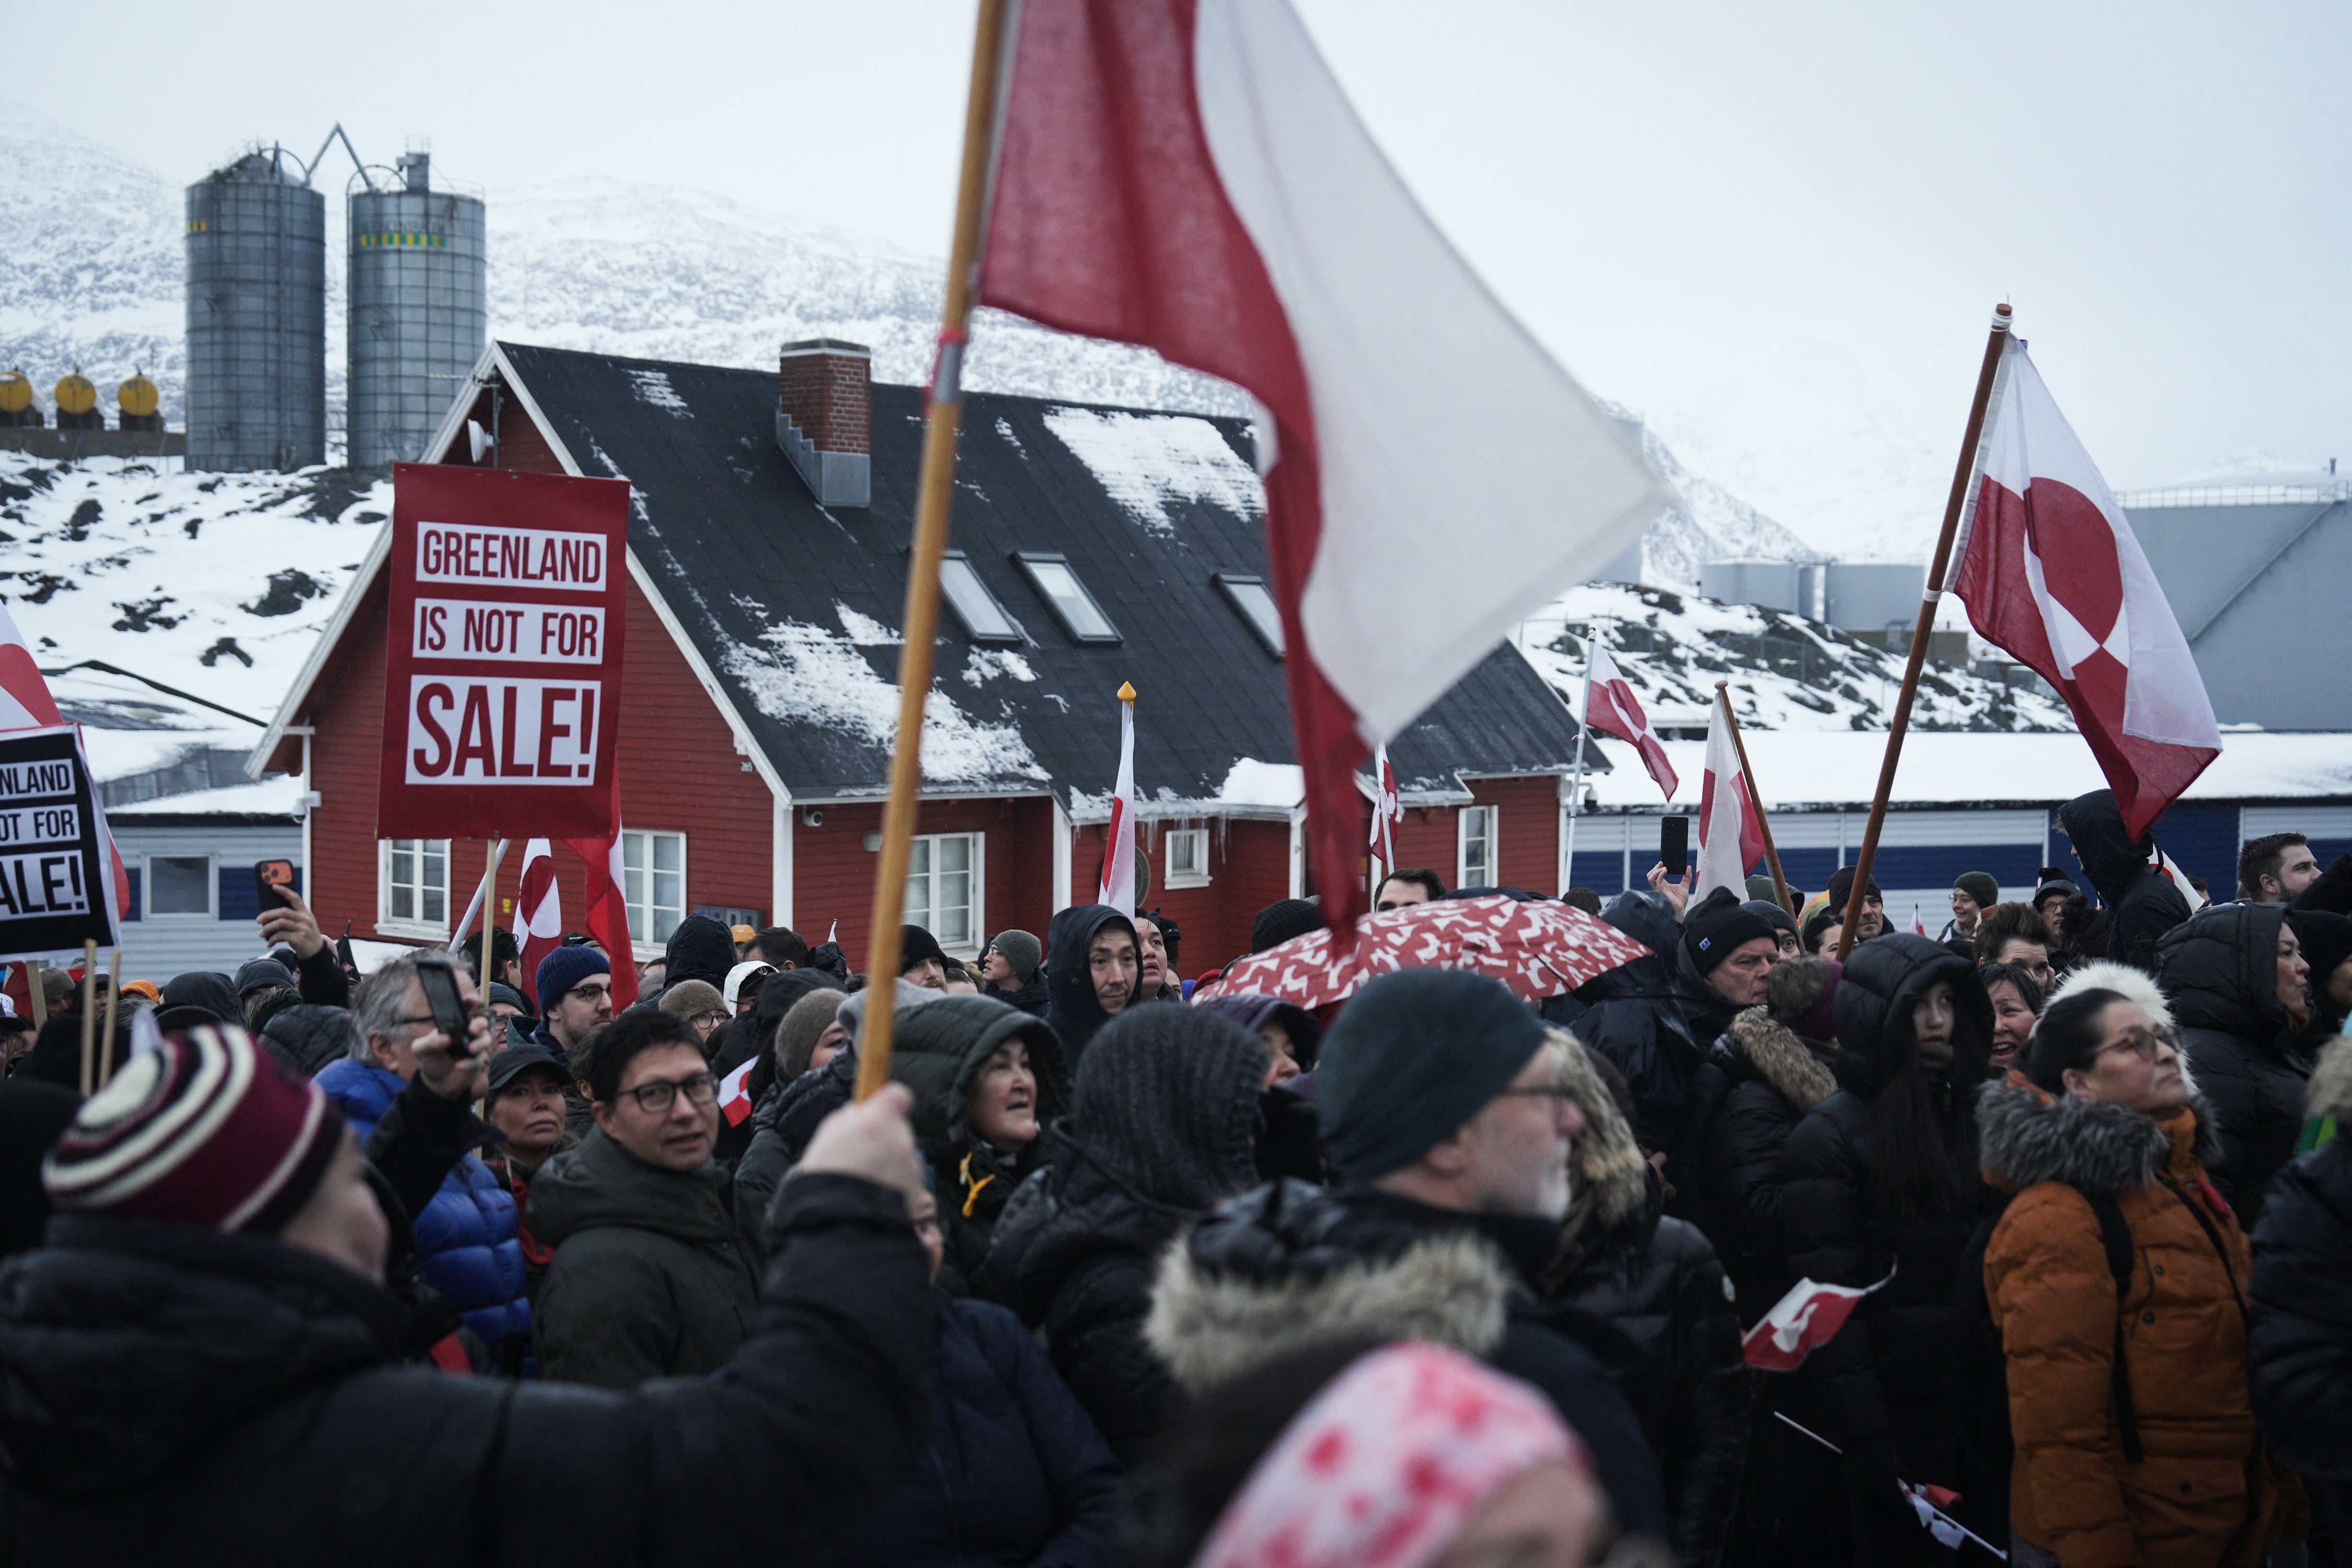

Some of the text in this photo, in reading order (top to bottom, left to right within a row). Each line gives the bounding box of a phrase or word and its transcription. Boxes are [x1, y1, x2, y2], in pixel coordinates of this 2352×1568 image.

[423, 529, 601, 584] GREENLAND
[419, 606, 598, 657] IS NOT FOR
[413, 682, 595, 778] SALE!
[33, 809, 75, 838] FOR
